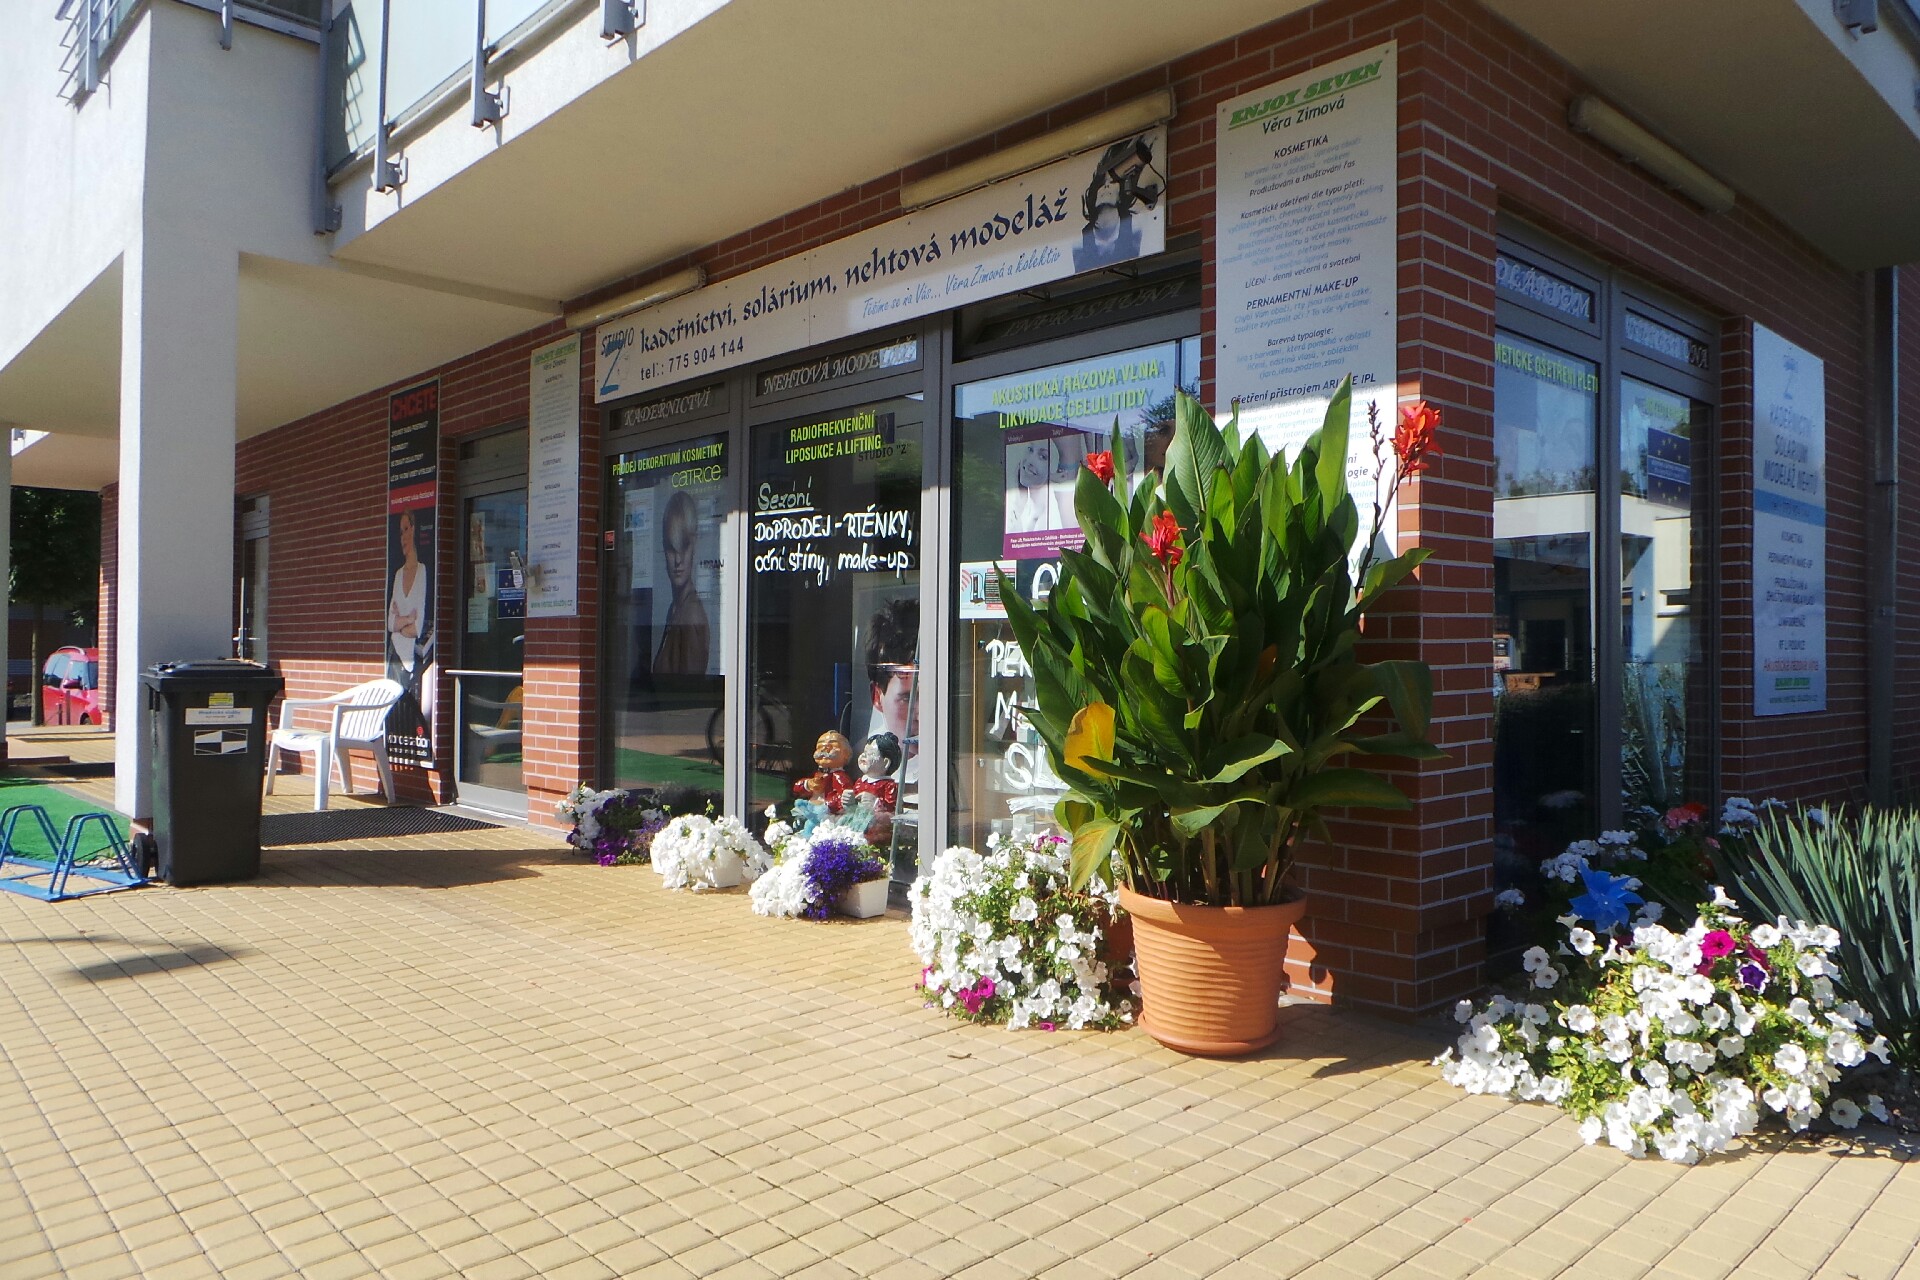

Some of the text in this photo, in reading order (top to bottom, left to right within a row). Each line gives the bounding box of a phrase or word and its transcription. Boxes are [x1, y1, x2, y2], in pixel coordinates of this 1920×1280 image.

[1228, 60, 1382, 125] ENJOY SEVEN
[1262, 93, 1345, 134] Věra Zimová
[1273, 133, 1329, 159] KOSMETIKA
[1240, 202, 1278, 219] Kosmetické
[1324, 183, 1342, 197] typu
[743, 274, 837, 321] solárium,
[845, 233, 941, 288] nehtová
[950, 187, 1068, 255] modeláž
[945, 274, 969, 295] Věra
[971, 262, 1004, 287] Zimová
[1014, 247, 1062, 275] kolektiv
[1246, 276, 1359, 310] PERNAMENTNÍ MAKE-UP
[1495, 257, 1590, 319] OLÁRIUM
[668, 355, 690, 373] 775
[693, 345, 716, 366] 904
[720, 336, 744, 357] 144
[1267, 334, 1295, 346] Barevná
[763, 356, 830, 395] NEHTOVÁ
[992, 373, 1059, 406] AKUSTICKÁ
[1122, 358, 1160, 381] VLNA
[1322, 375, 1358, 389] ARIE
[1360, 372, 1376, 383] IPL
[391, 386, 437, 421] CHCETE
[624, 386, 711, 426] KADEŘNICTVÍ
[999, 388, 1147, 429] LIKVIDACE CELULITIDY
[790, 410, 876, 443] RADIOFREKVENČNÍ
[612, 442, 723, 476] PRODEJ DEKORATIVNÍ KOSMETIKY
[785, 434, 882, 464] LIPOSUKCE A LIFTING
[858, 446, 894, 462] STUDIO
[788, 542, 830, 587] stíny,
[838, 542, 909, 579] make-up
